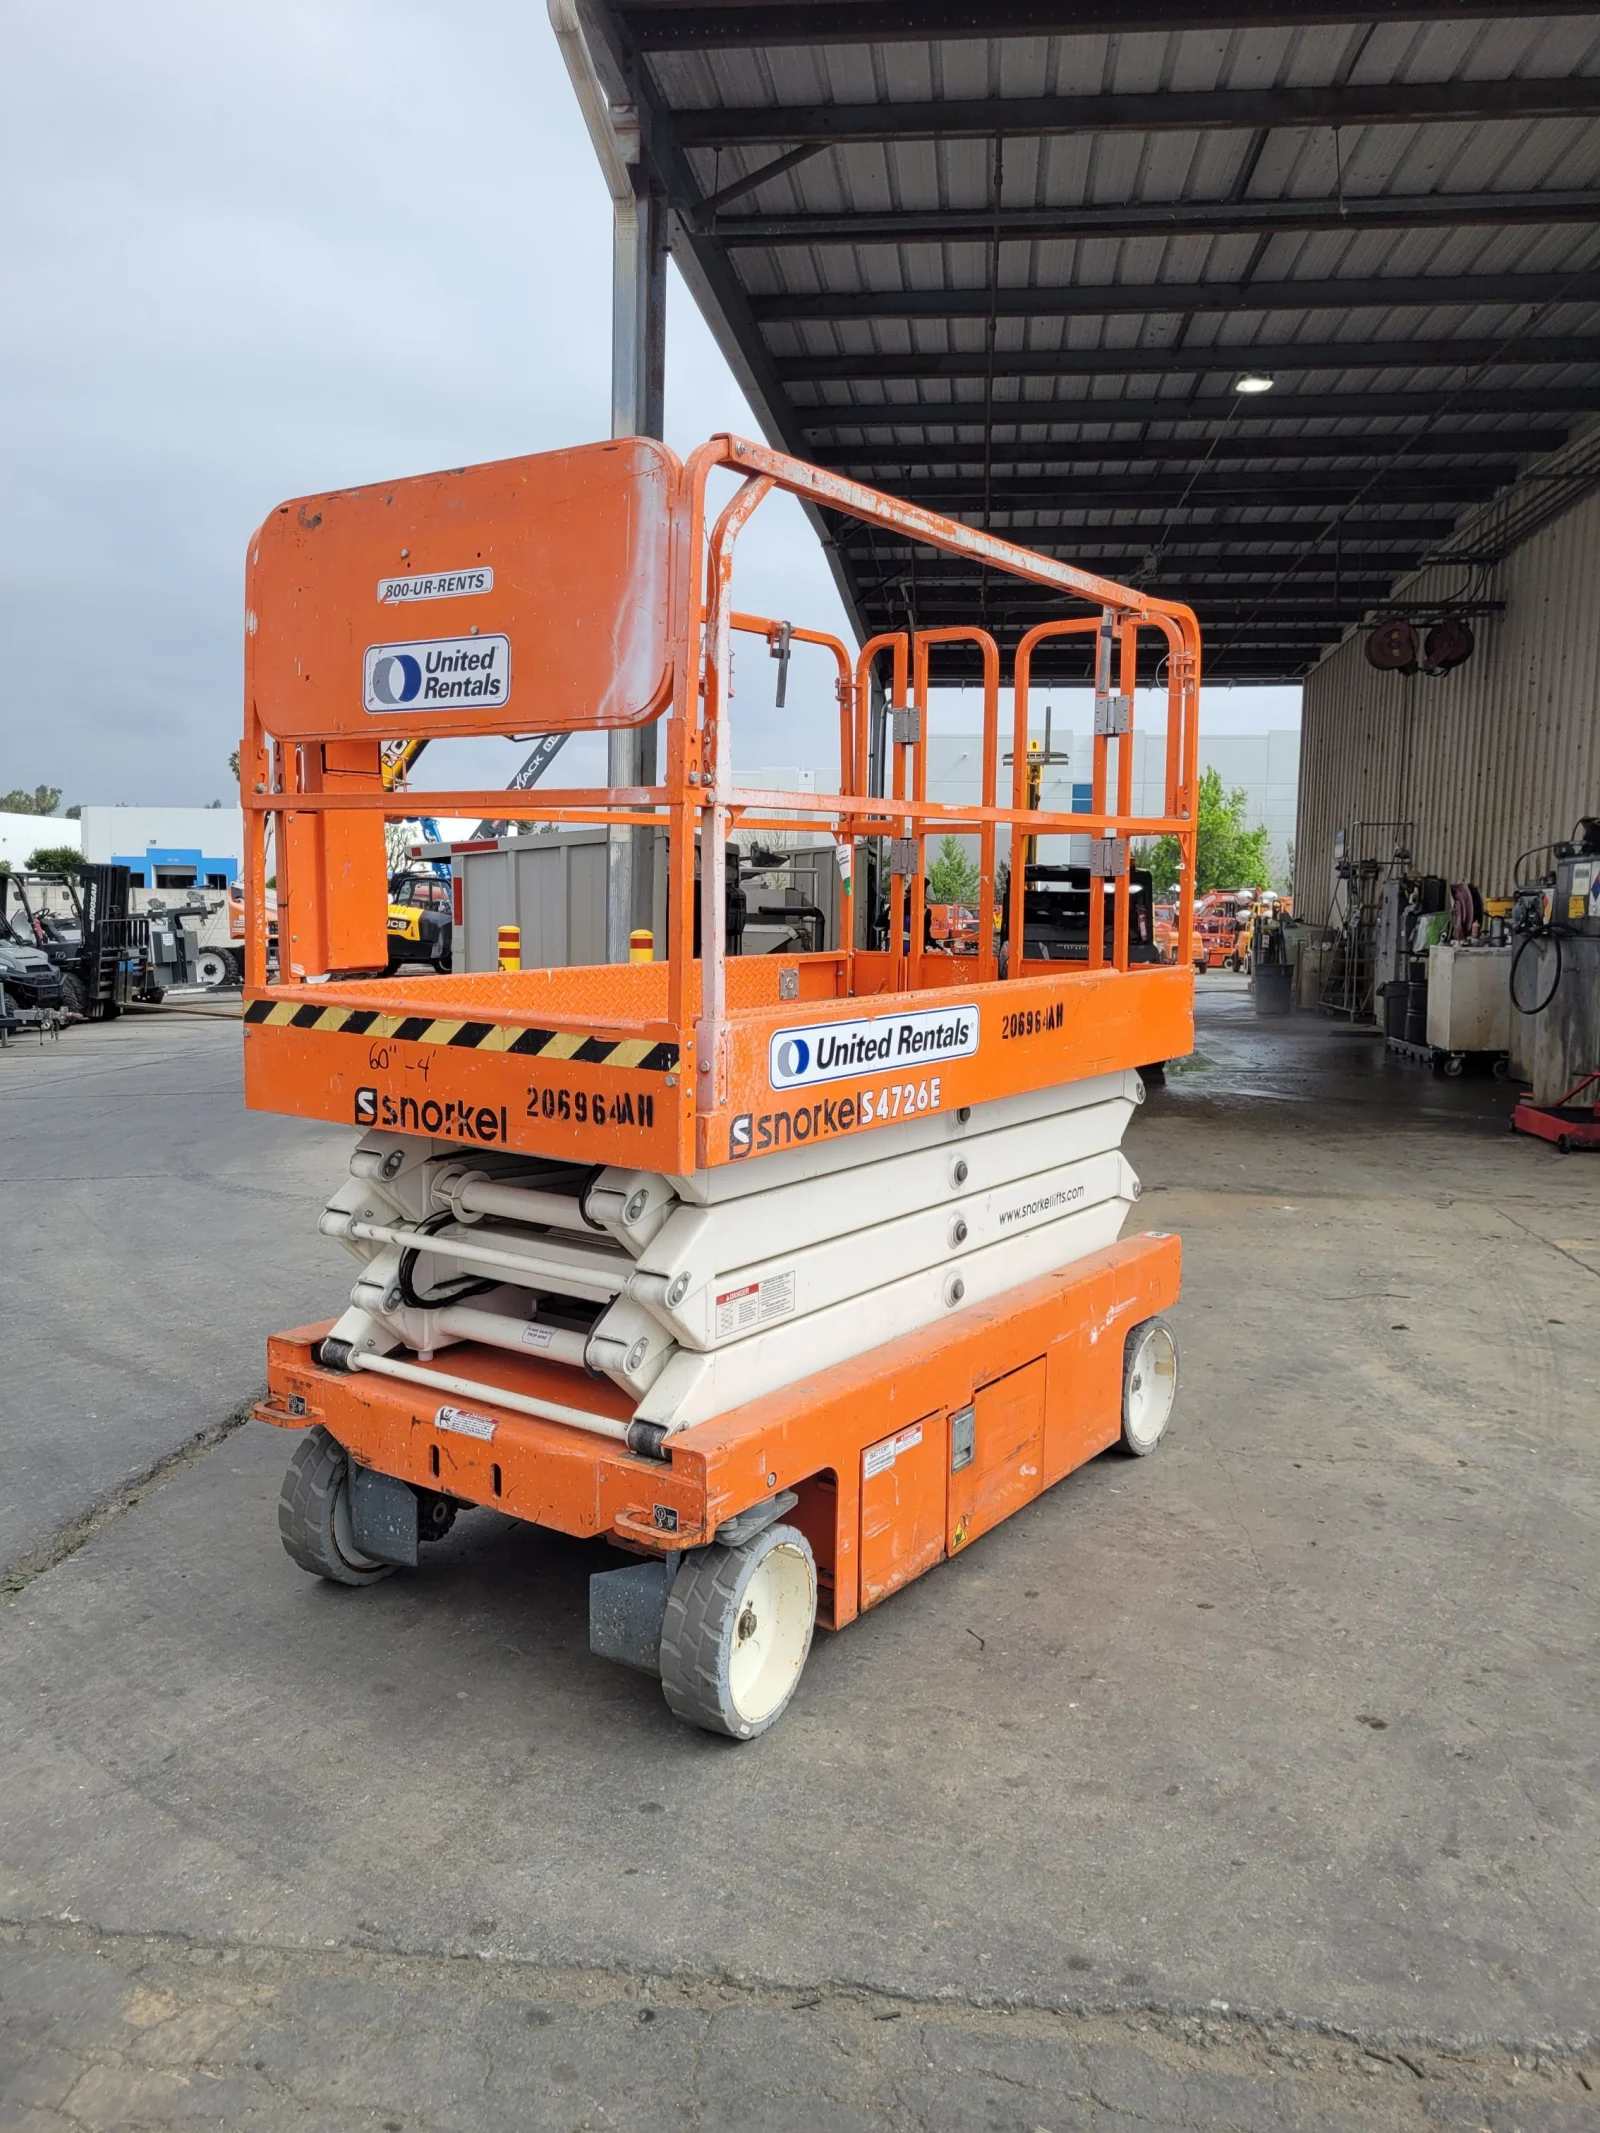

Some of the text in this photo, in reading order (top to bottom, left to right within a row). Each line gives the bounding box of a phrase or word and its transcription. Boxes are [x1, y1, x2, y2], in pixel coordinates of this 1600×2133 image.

[385, 573, 485, 597] 800-UR-RENTS
[425, 646, 496, 674] United
[424, 673, 501, 699] Rentals
[89, 882, 97, 921] DOOSAN
[816, 1017, 970, 1070] United Rentals
[861, 1077, 941, 1125] S4726E
[999, 1185, 1085, 1226] www.snorkellifts.com
[730, 1288, 749, 1300] DANGER
